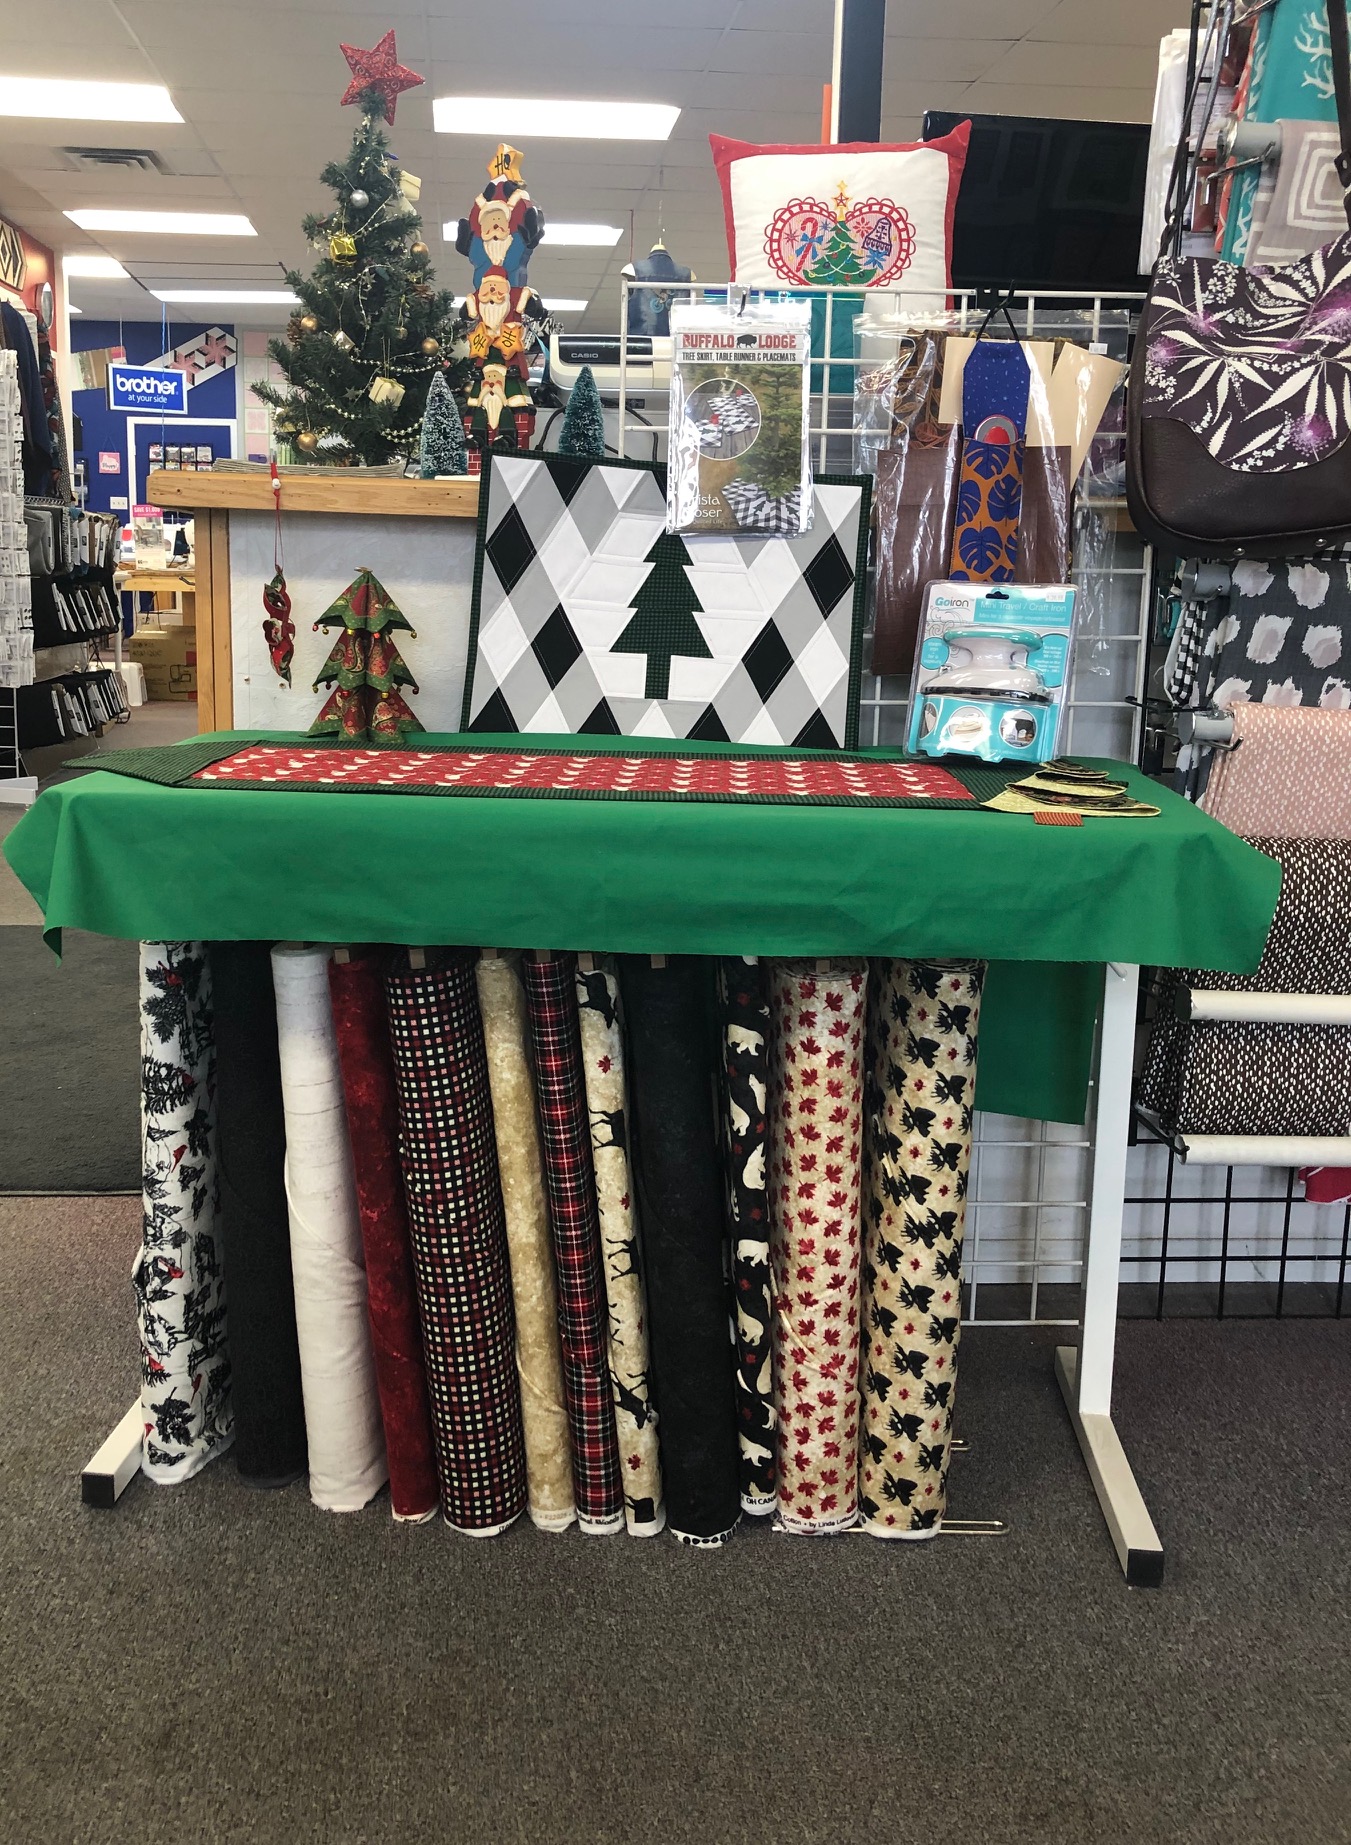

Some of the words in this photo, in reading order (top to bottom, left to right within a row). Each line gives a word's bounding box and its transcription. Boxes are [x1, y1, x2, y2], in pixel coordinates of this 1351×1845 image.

[682, 334, 735, 348] BUFFALO
[758, 334, 797, 348] LODGE
[682, 352, 695, 361] TREE
[696, 352, 715, 362] SKIRT,
[716, 352, 733, 361] TABLE
[734, 352, 756, 361] RUNNER
[763, 352, 796, 362] PLACEMATS
[116, 374, 178, 395] brother
[136, 395, 152, 403] your
[153, 395, 168, 403] side
[980, 601, 997, 609] Mini
[999, 601, 1021, 611] Travel
[1029, 602, 1049, 611] Craft
[1050, 604, 1067, 613] Iron
[746, 1497, 757, 1505] OH
